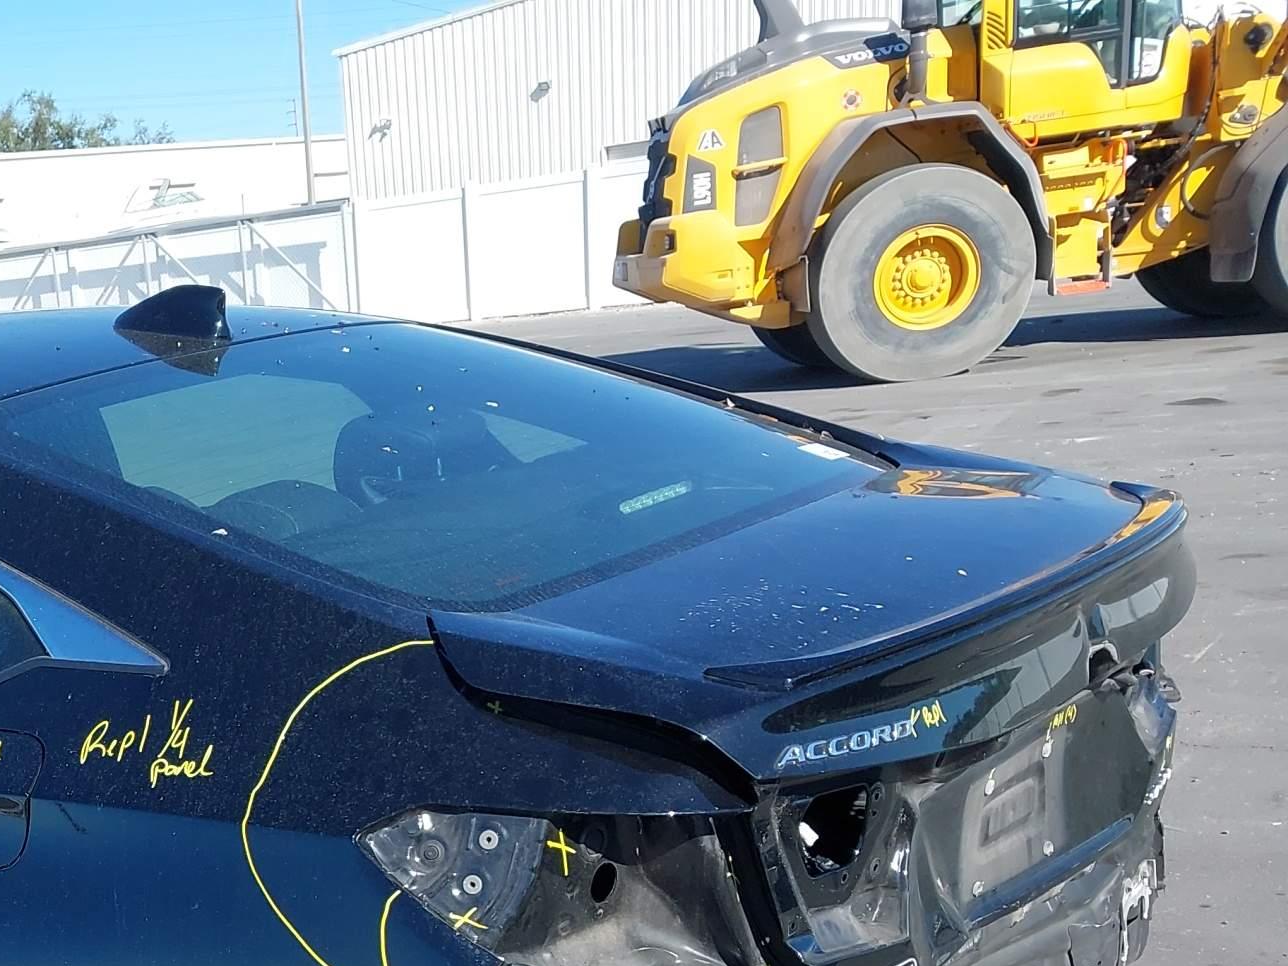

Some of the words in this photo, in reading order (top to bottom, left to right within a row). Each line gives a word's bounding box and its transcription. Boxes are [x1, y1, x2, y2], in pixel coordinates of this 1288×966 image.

[834, 42, 909, 65] VOLVO
[692, 172, 712, 206] L90H
[80, 714, 152, 765] Repl
[158, 699, 194, 758] 1/4
[775, 719, 913, 769] ACCORD
[150, 745, 214, 788] panel
